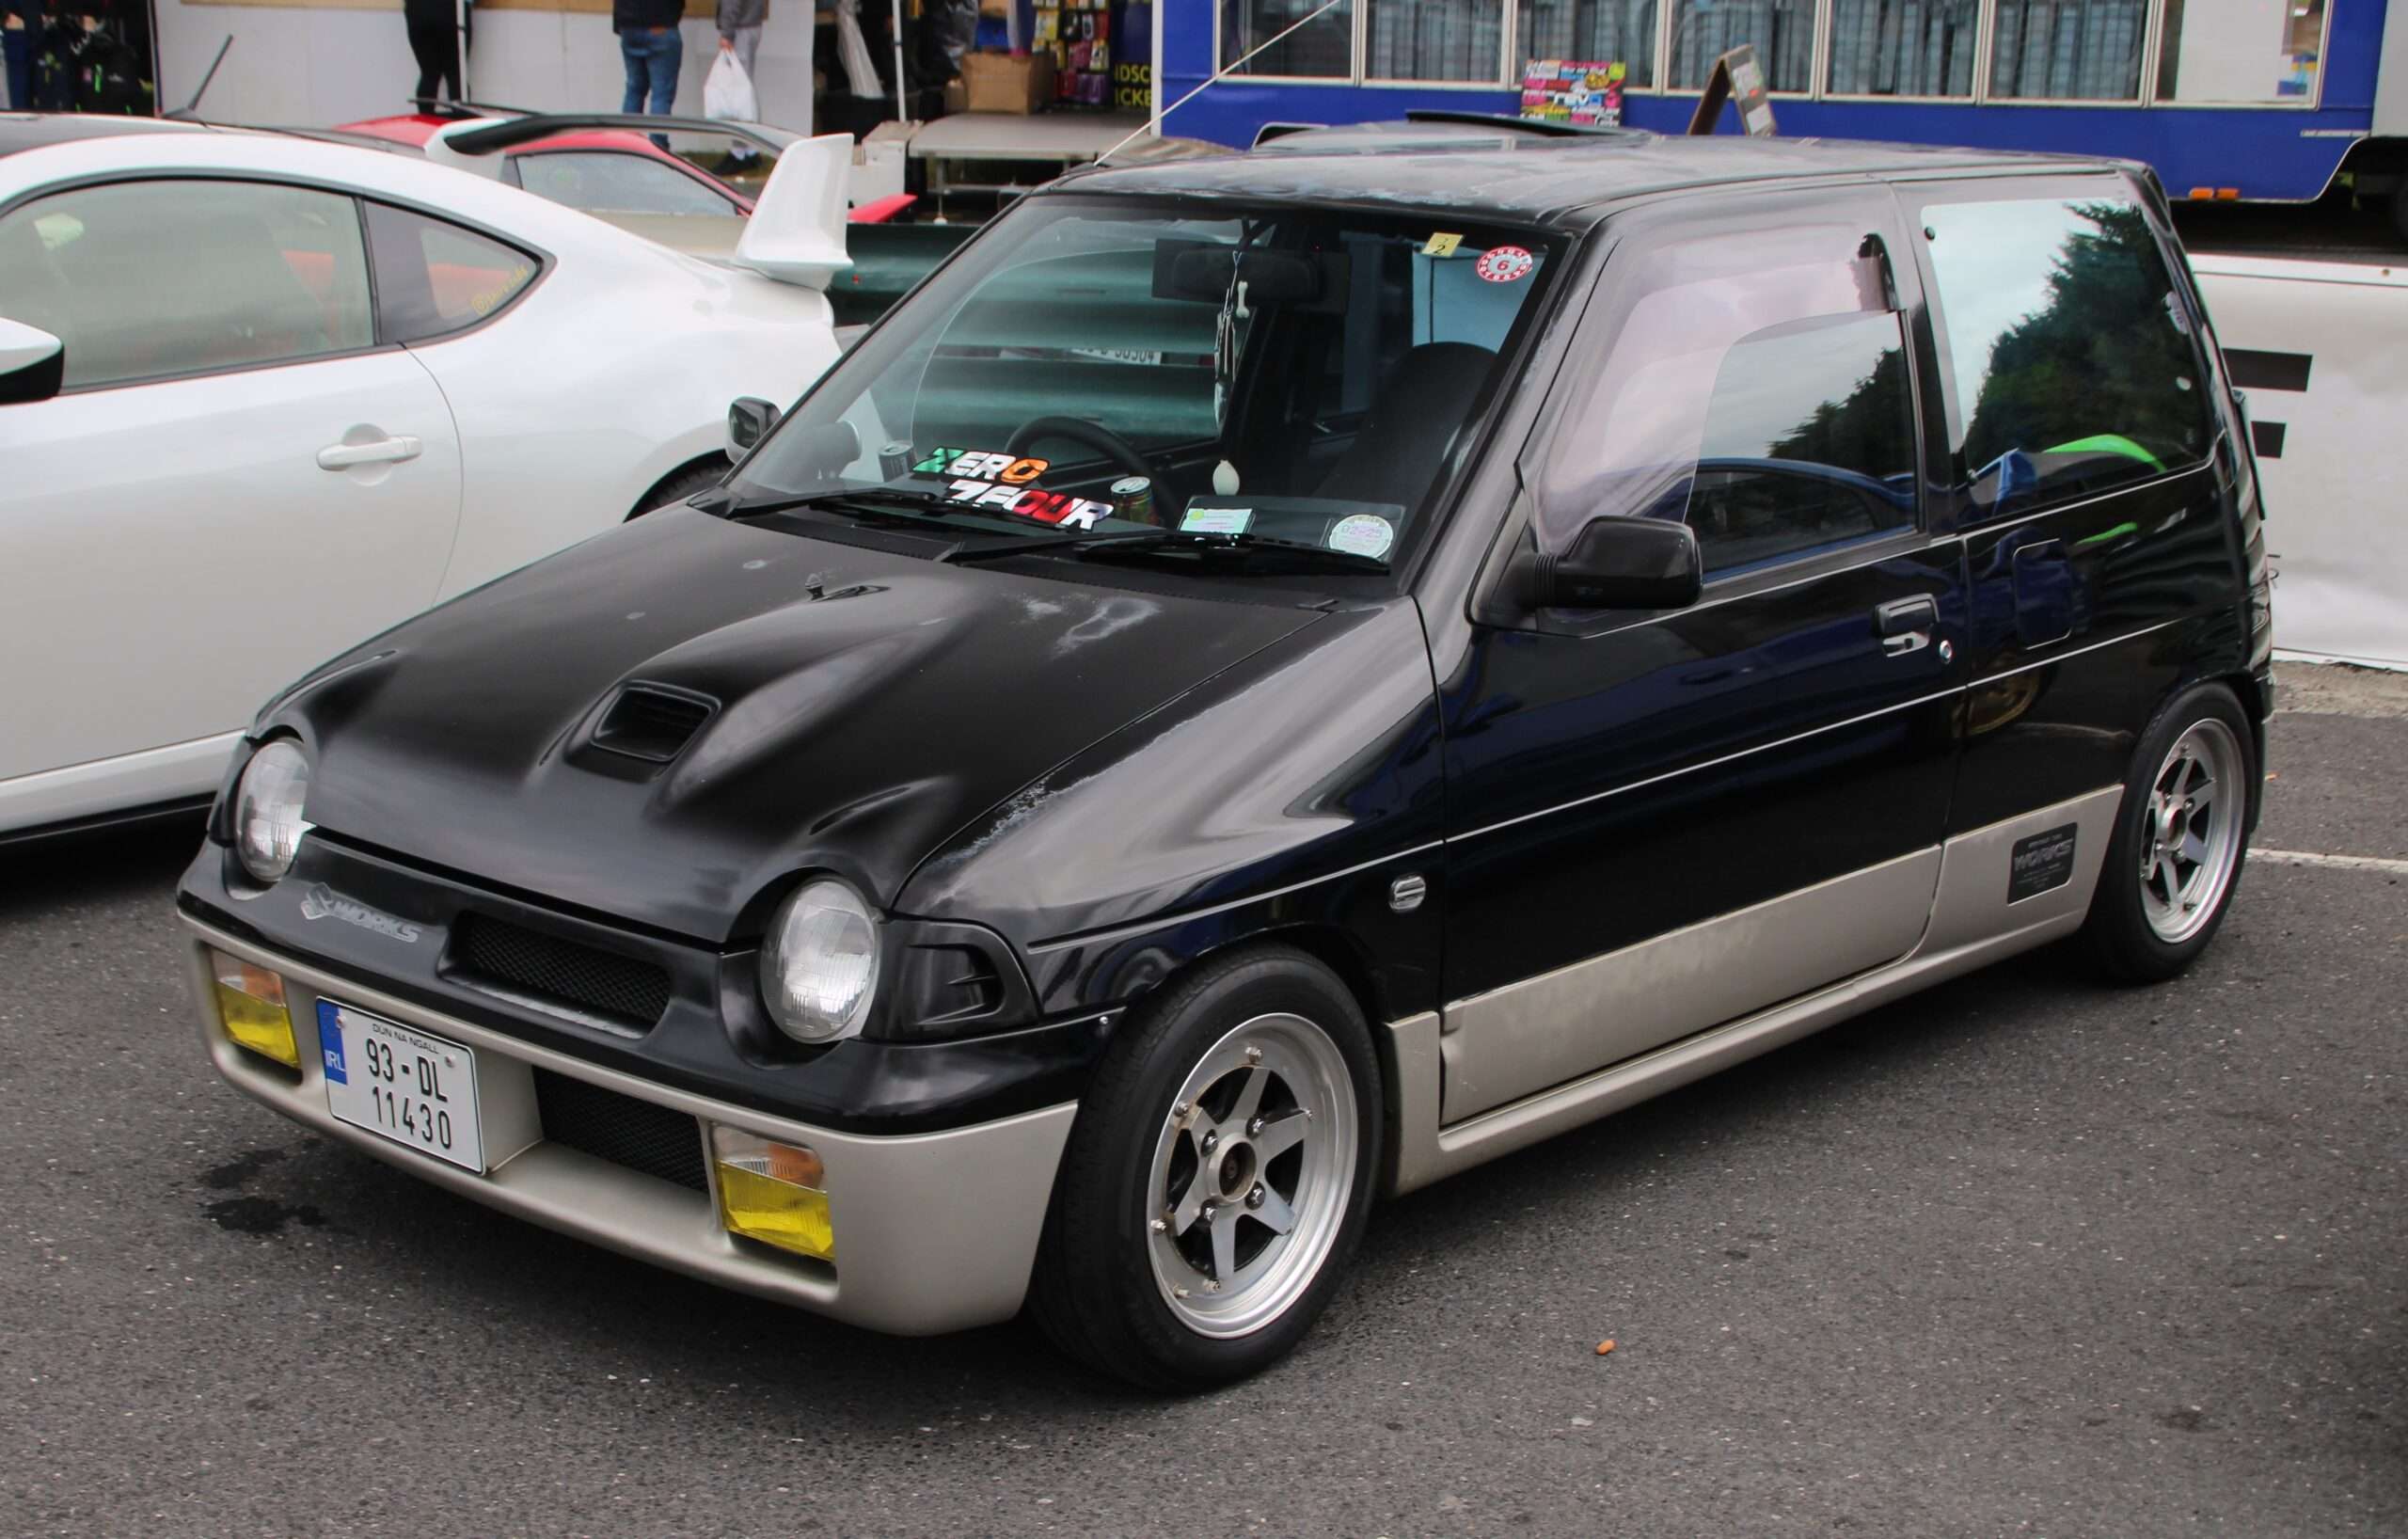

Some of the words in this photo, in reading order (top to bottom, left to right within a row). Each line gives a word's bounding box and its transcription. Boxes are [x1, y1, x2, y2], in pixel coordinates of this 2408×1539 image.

[1497, 260, 1510, 271] 6
[912, 447, 1050, 484] ZERO
[2015, 837, 2074, 872] WORKS
[333, 901, 422, 943] WORKS
[324, 1049, 346, 1071] IRL
[372, 1086, 452, 1150] 11430
